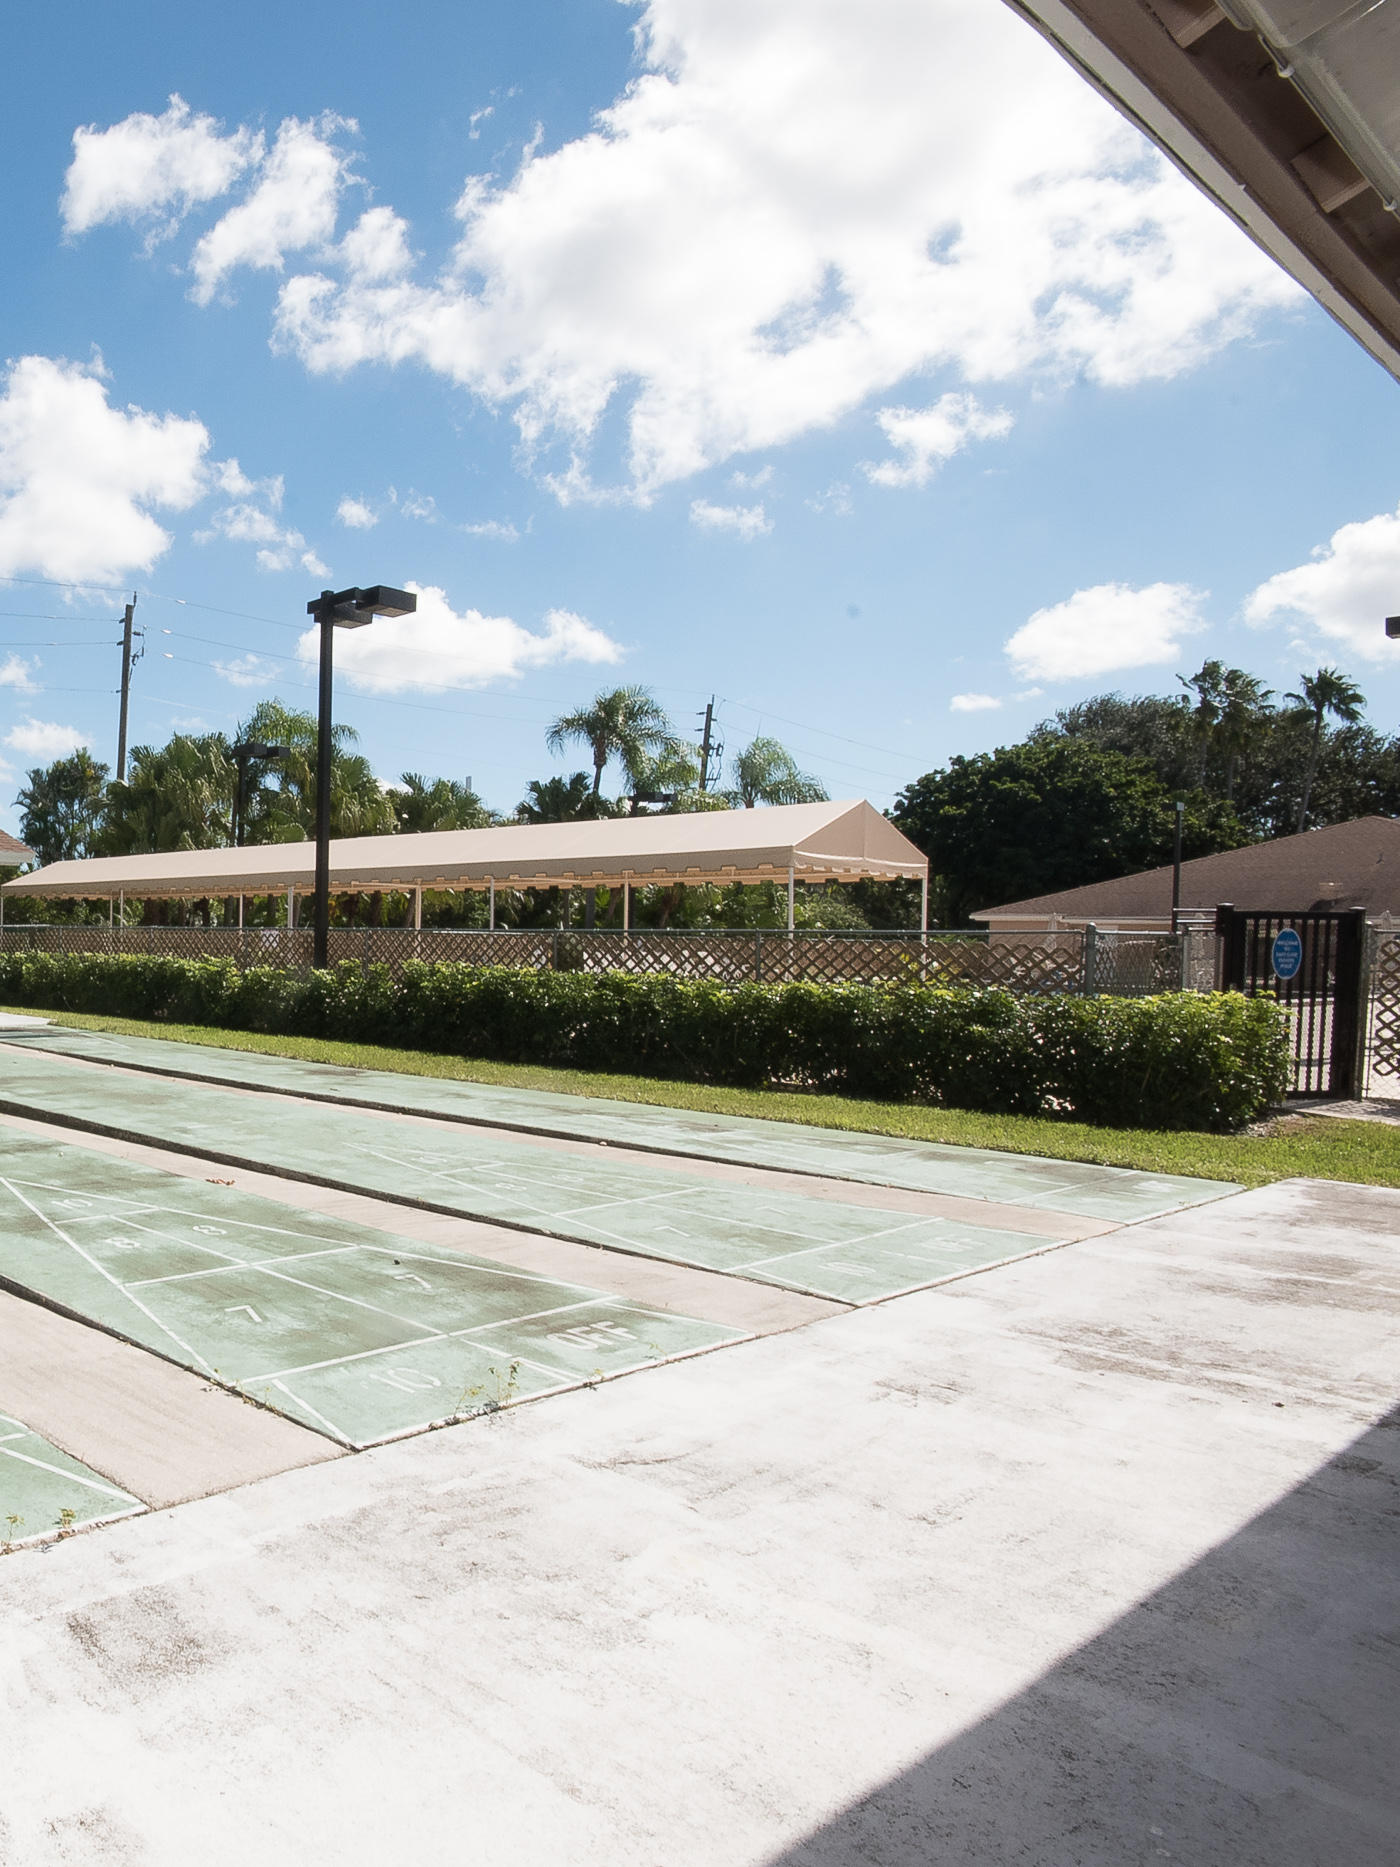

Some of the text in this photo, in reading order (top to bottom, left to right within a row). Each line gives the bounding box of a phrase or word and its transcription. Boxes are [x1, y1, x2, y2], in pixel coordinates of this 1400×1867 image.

[192, 1225, 227, 1236] 8
[105, 1237, 142, 1249] 8
[394, 1273, 432, 1290] 7
[224, 1305, 264, 1323] 7
[546, 1321, 638, 1350] OFF
[369, 1367, 442, 1394] 10
